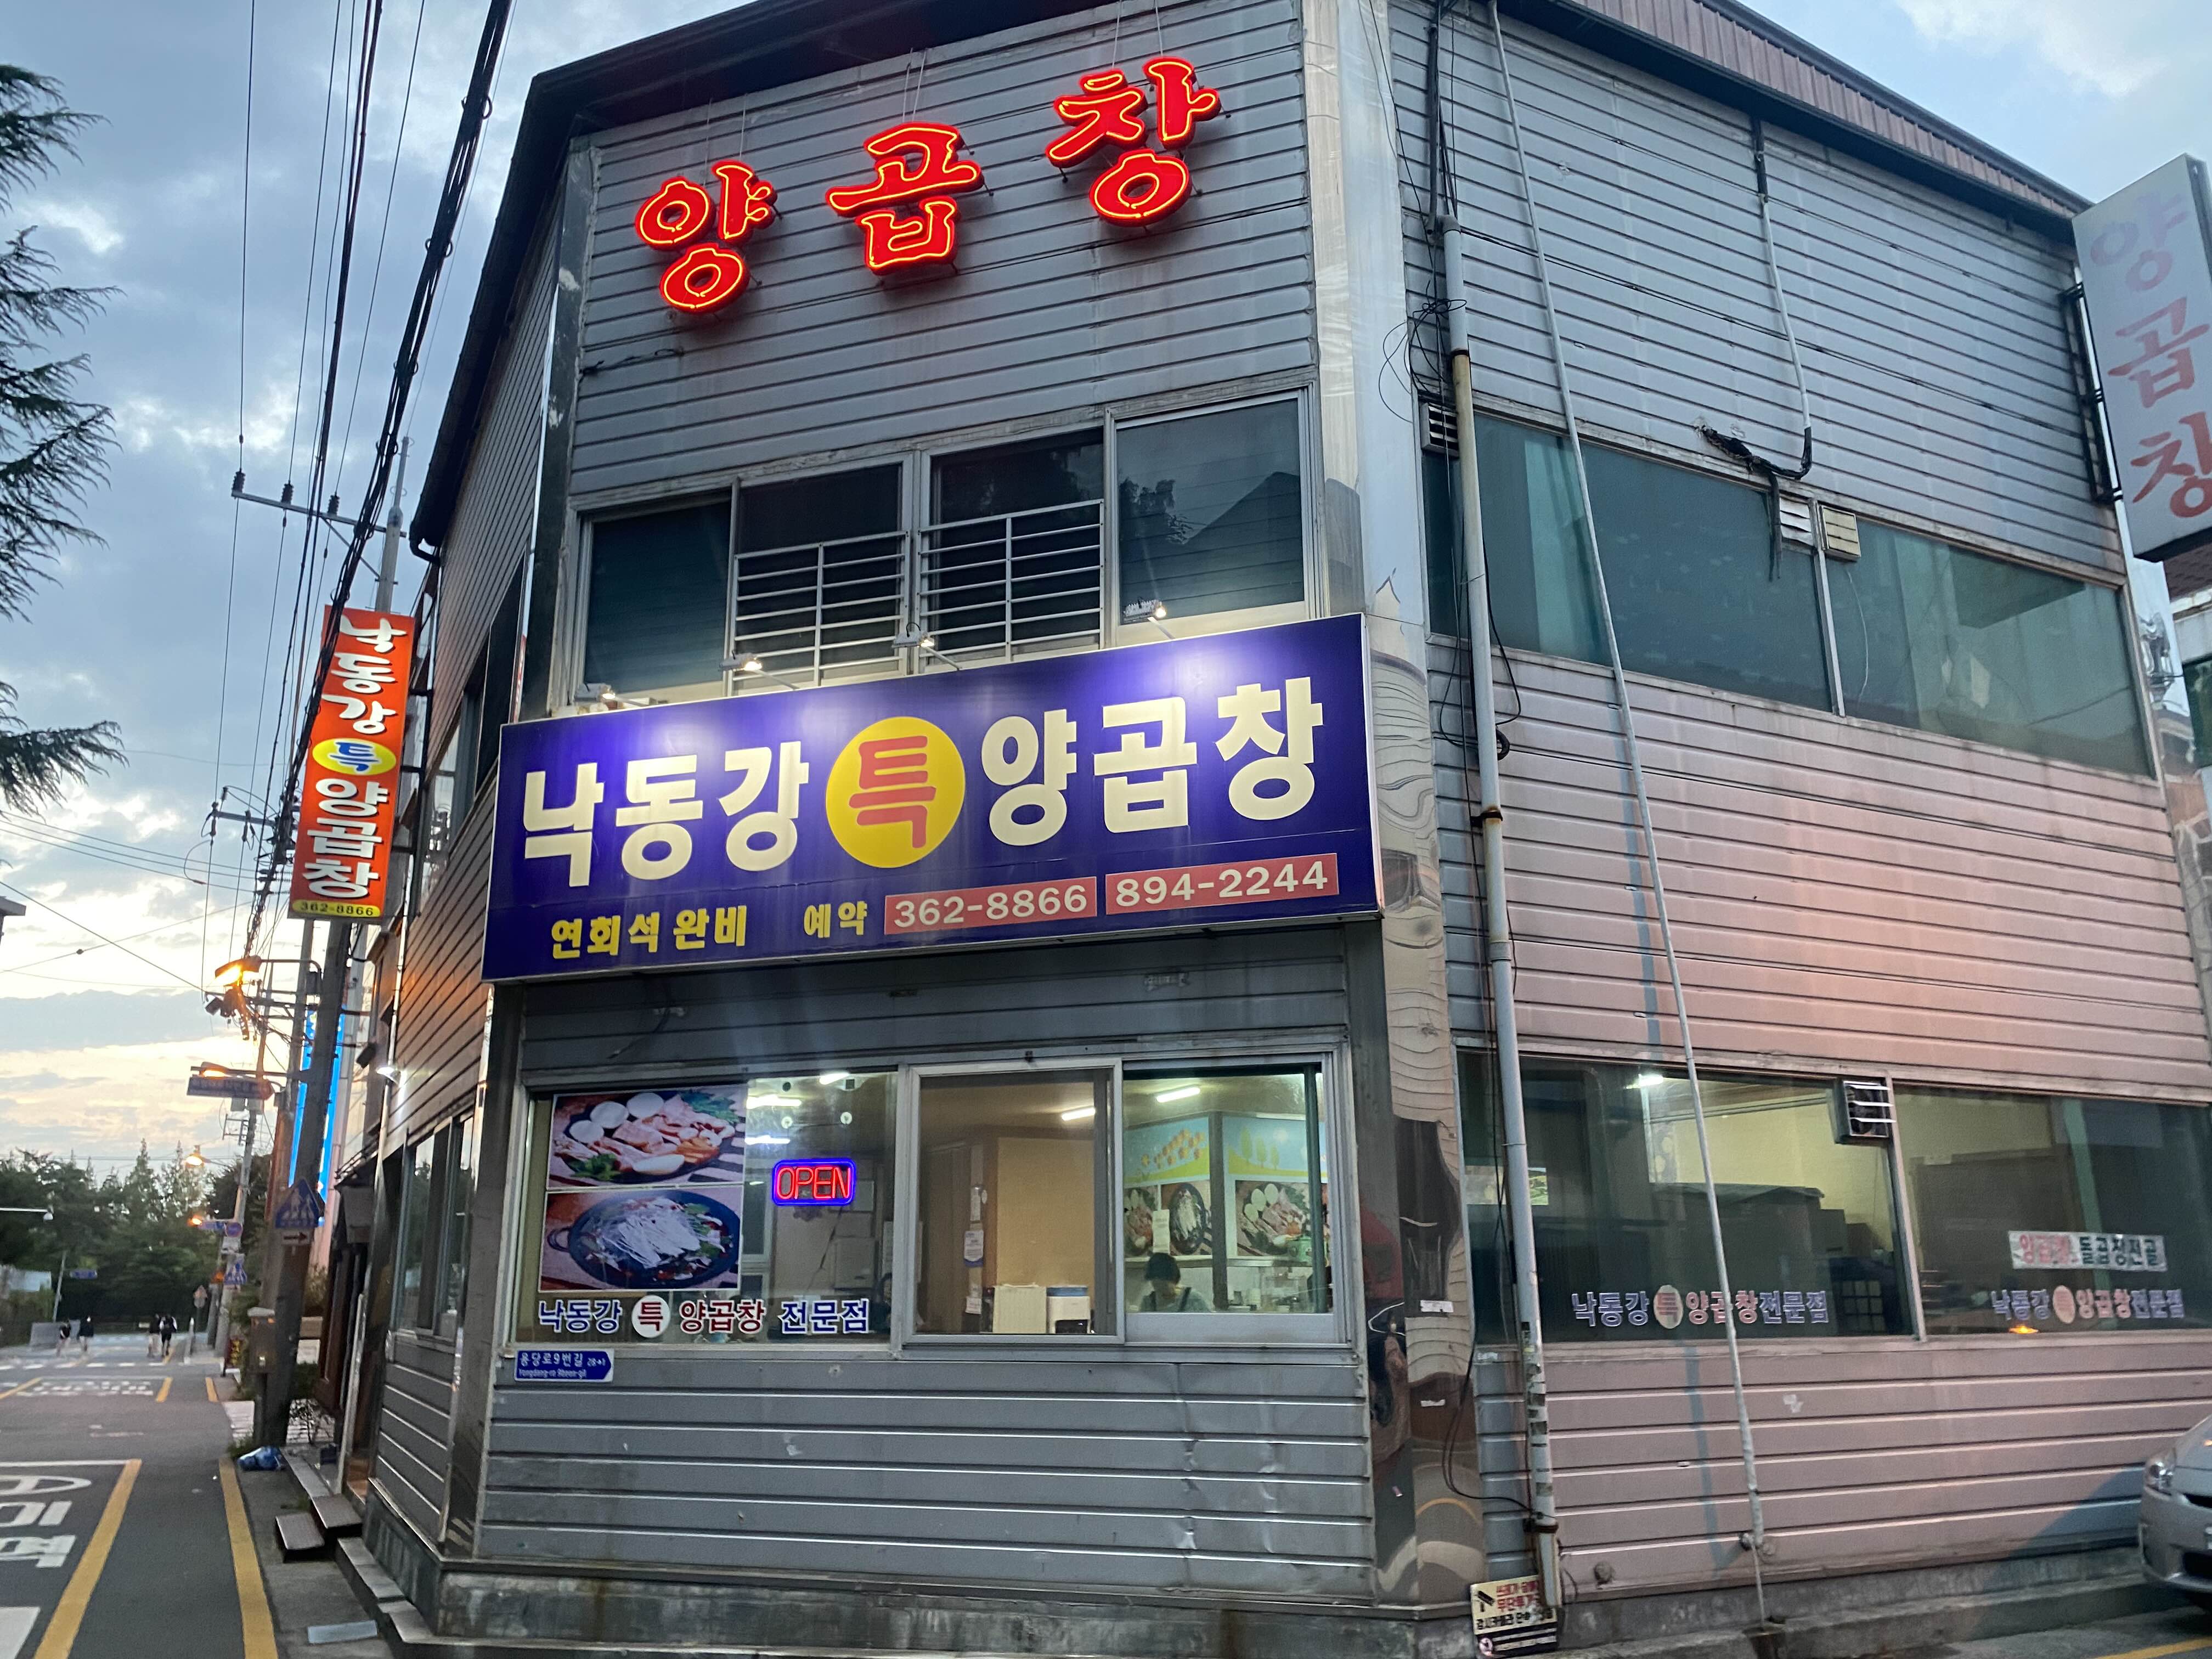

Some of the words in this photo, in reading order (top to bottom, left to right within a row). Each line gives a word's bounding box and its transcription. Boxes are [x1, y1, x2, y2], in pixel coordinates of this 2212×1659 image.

[635, 57, 1221, 314] 양곱창
[330, 741, 380, 772] 특
[523, 741, 809, 887] 낙동강
[849, 735, 936, 849] 특
[981, 676, 1323, 847] 양곱창
[302, 778, 389, 899] 양곱창
[551, 912, 660, 960] 연회석
[673, 905, 747, 950] 완비
[804, 901, 867, 939] 예약
[895, 884, 1087, 928] 362-8866
[1116, 860, 1328, 907] 894-2244
[775, 1166, 851, 1200] OPEN
[539, 1299, 622, 1334] 낙동강
[638, 1302, 663, 1331] 특
[679, 1299, 766, 1334] 양곱창
[777, 1299, 869, 1334] 전문점
[1572, 1291, 1649, 1327] 낙동강
[1657, 1291, 1679, 1322] 특
[1991, 1289, 2050, 1321] 낙동강
